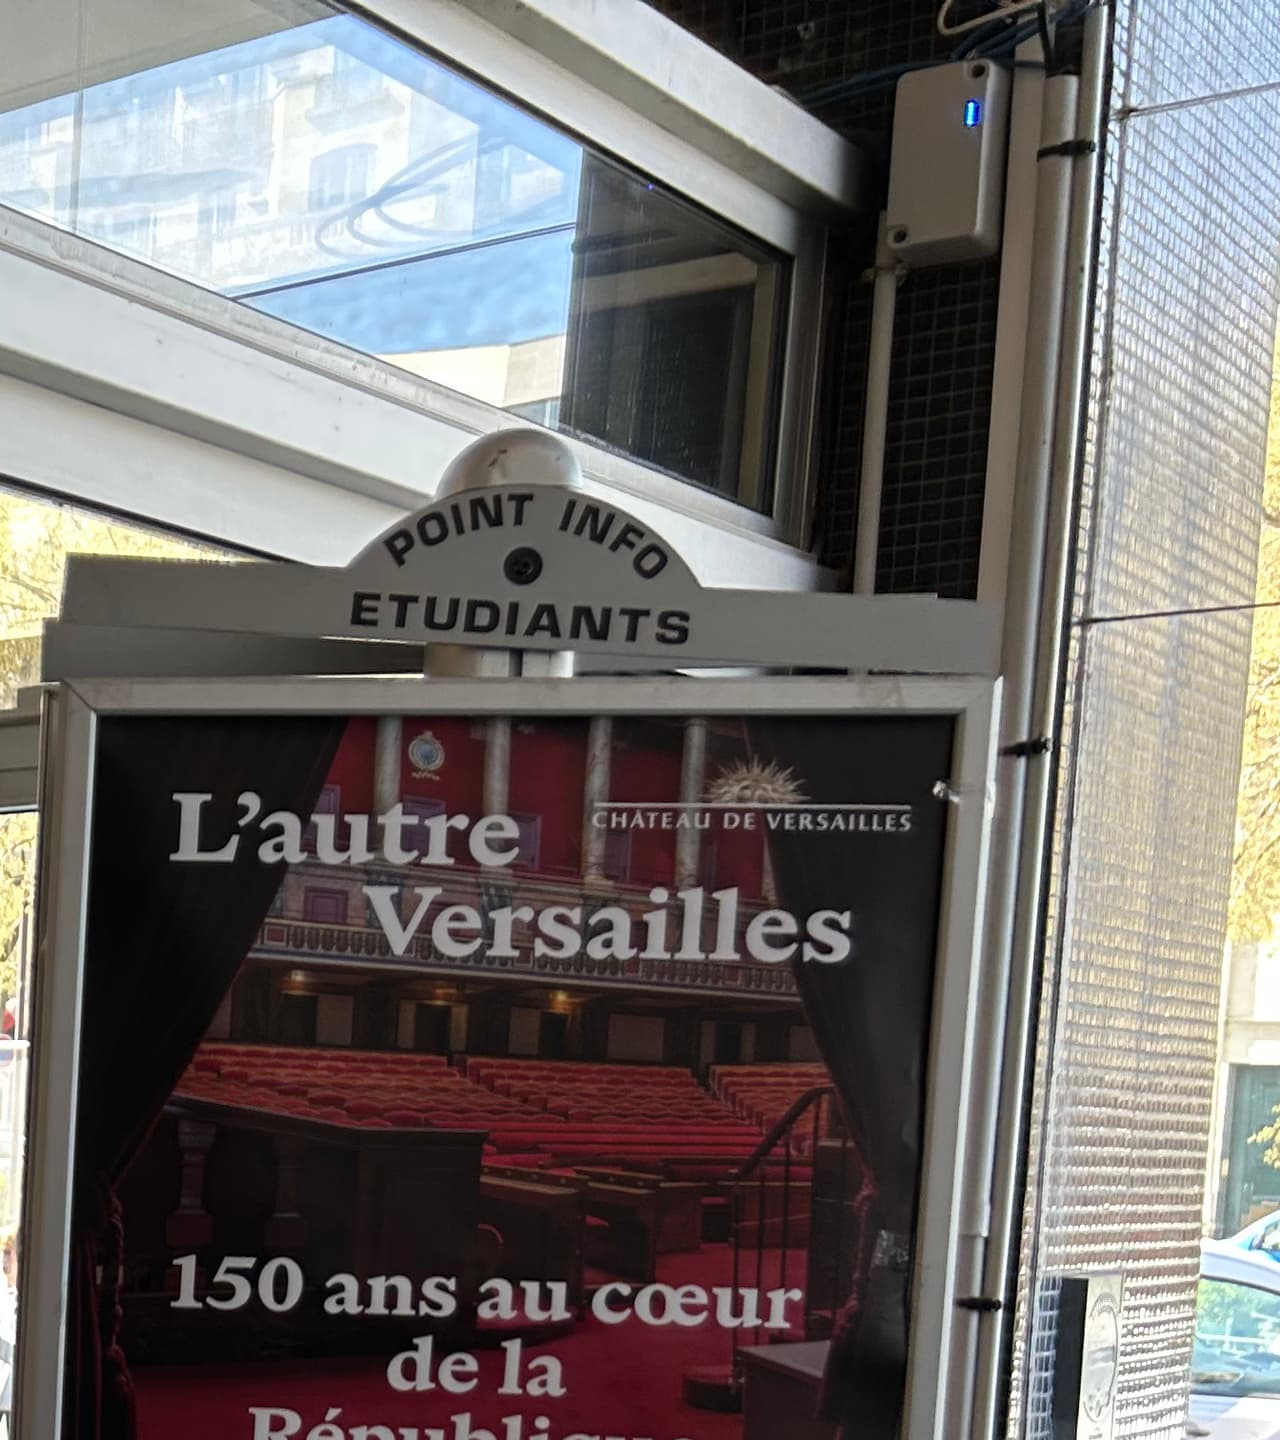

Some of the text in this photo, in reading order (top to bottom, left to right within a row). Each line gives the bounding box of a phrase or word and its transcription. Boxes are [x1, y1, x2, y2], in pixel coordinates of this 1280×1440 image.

[384, 493, 669, 580] POINT INFO
[350, 591, 690, 645] ETUDIANTS
[592, 809, 913, 833] CHÂTEAU DE VERSAILLES
[363, 885, 853, 963] Versailles
[169, 1254, 804, 1330] 150 ans au cœur
[386, 1336, 567, 1398] de la
